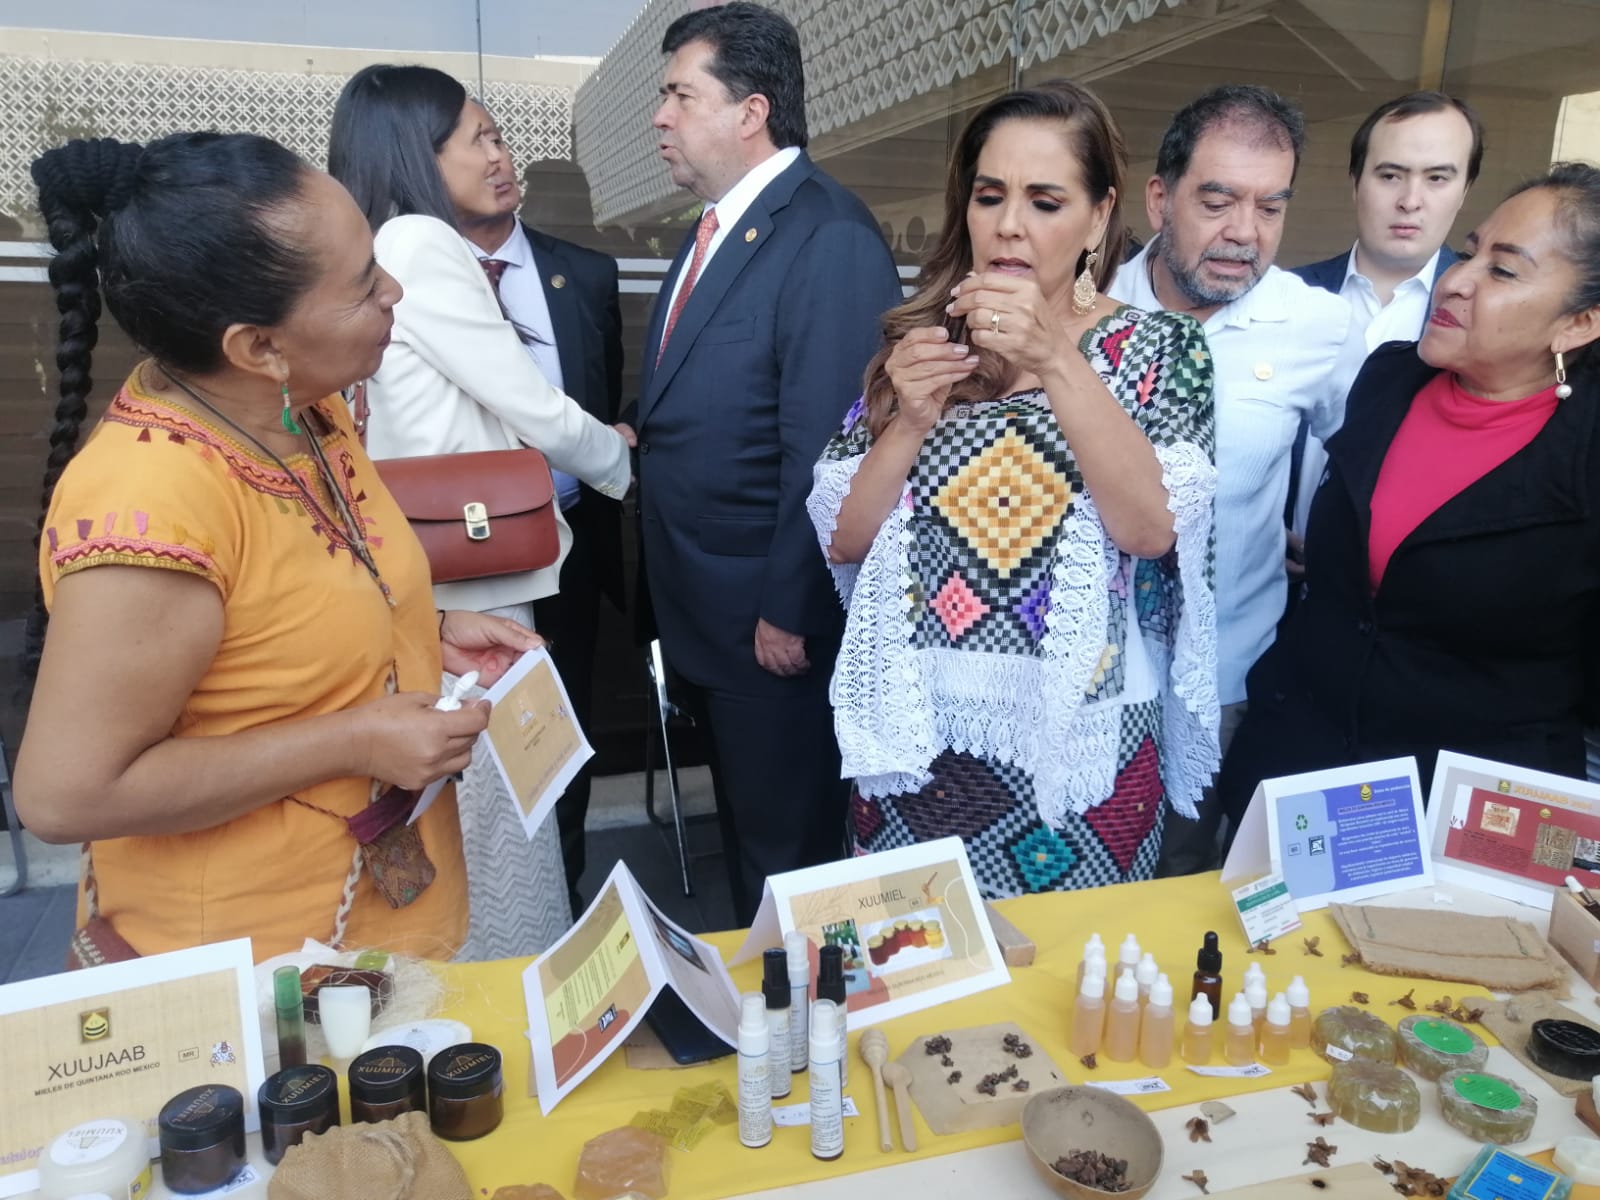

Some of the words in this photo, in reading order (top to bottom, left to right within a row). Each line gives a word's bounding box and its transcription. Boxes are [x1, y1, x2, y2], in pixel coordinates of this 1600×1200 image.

[858, 888, 906, 909] XUUMIEL
[48, 1045, 146, 1081] XUUJAAB
[358, 1065, 409, 1075] XUUMIEL
[448, 1053, 493, 1077] XUUMIEL
[34, 1085, 62, 1096] MIELES
[64, 1081, 75, 1089] DE
[76, 1072, 114, 1087] QUINTANA
[115, 1067, 132, 1077] ROO
[282, 1073, 328, 1104] XUUMIEL
[171, 1088, 215, 1124] XUUMIEL
